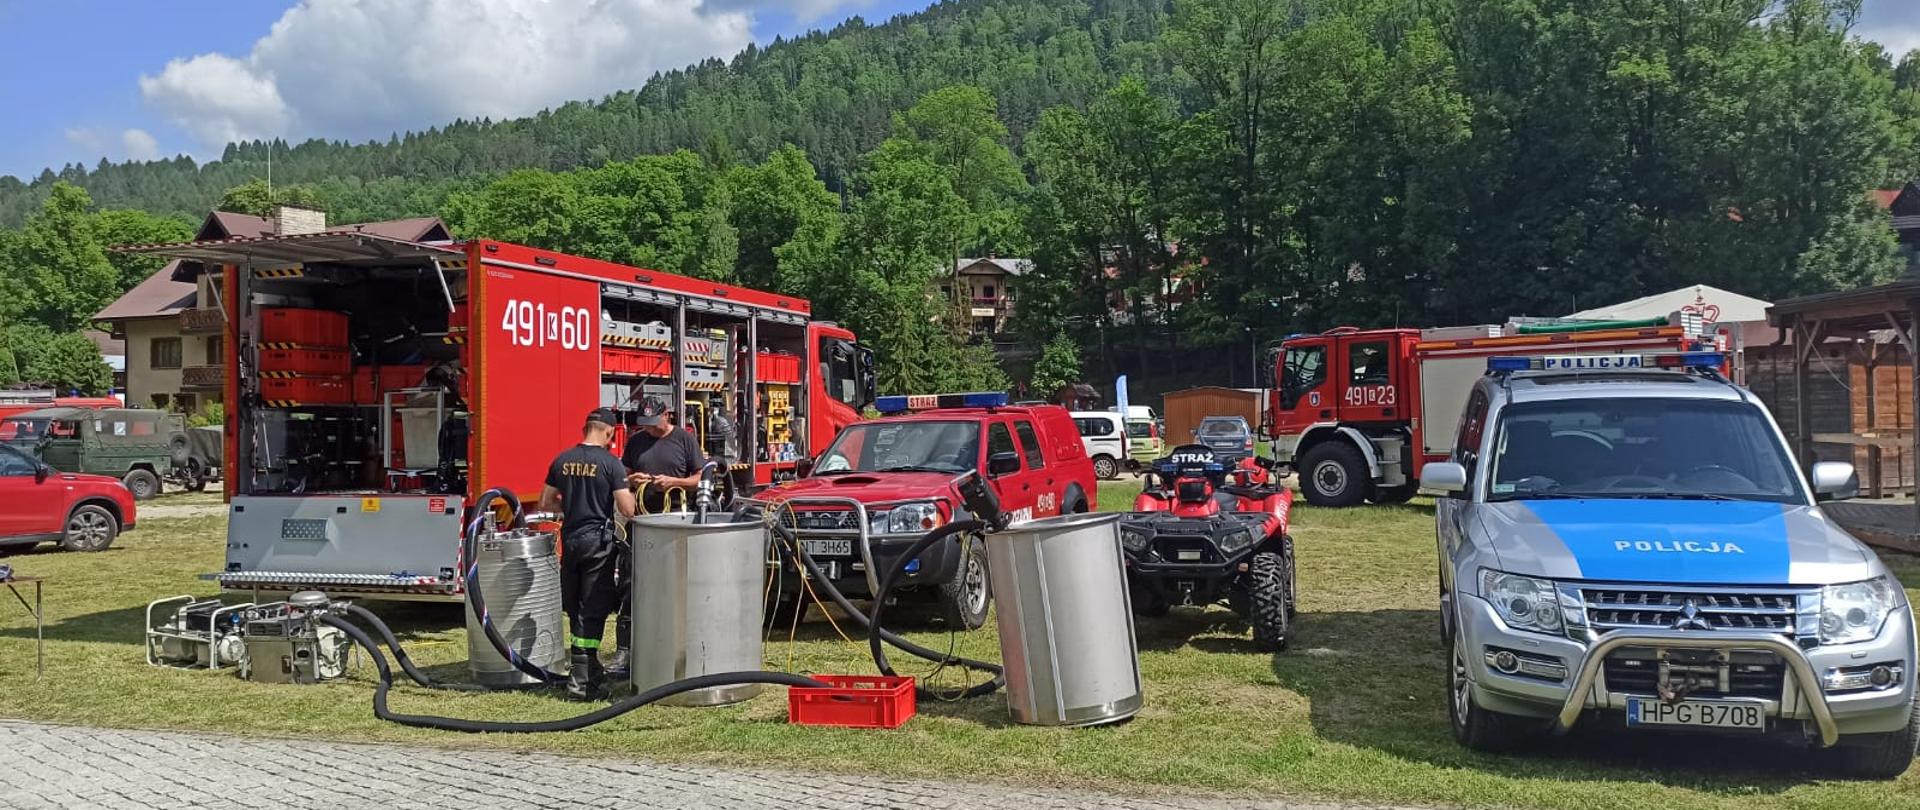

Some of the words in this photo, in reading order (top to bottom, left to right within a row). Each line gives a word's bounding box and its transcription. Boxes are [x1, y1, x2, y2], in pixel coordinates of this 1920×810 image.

[1546, 356, 1640, 368] POLICJA
[1172, 451, 1214, 464] STRAŻ
[821, 541, 849, 554] 3H65
[1614, 540, 1744, 553] POLICJA
[1643, 702, 1692, 723] HPG
[1701, 705, 1758, 726] B708
